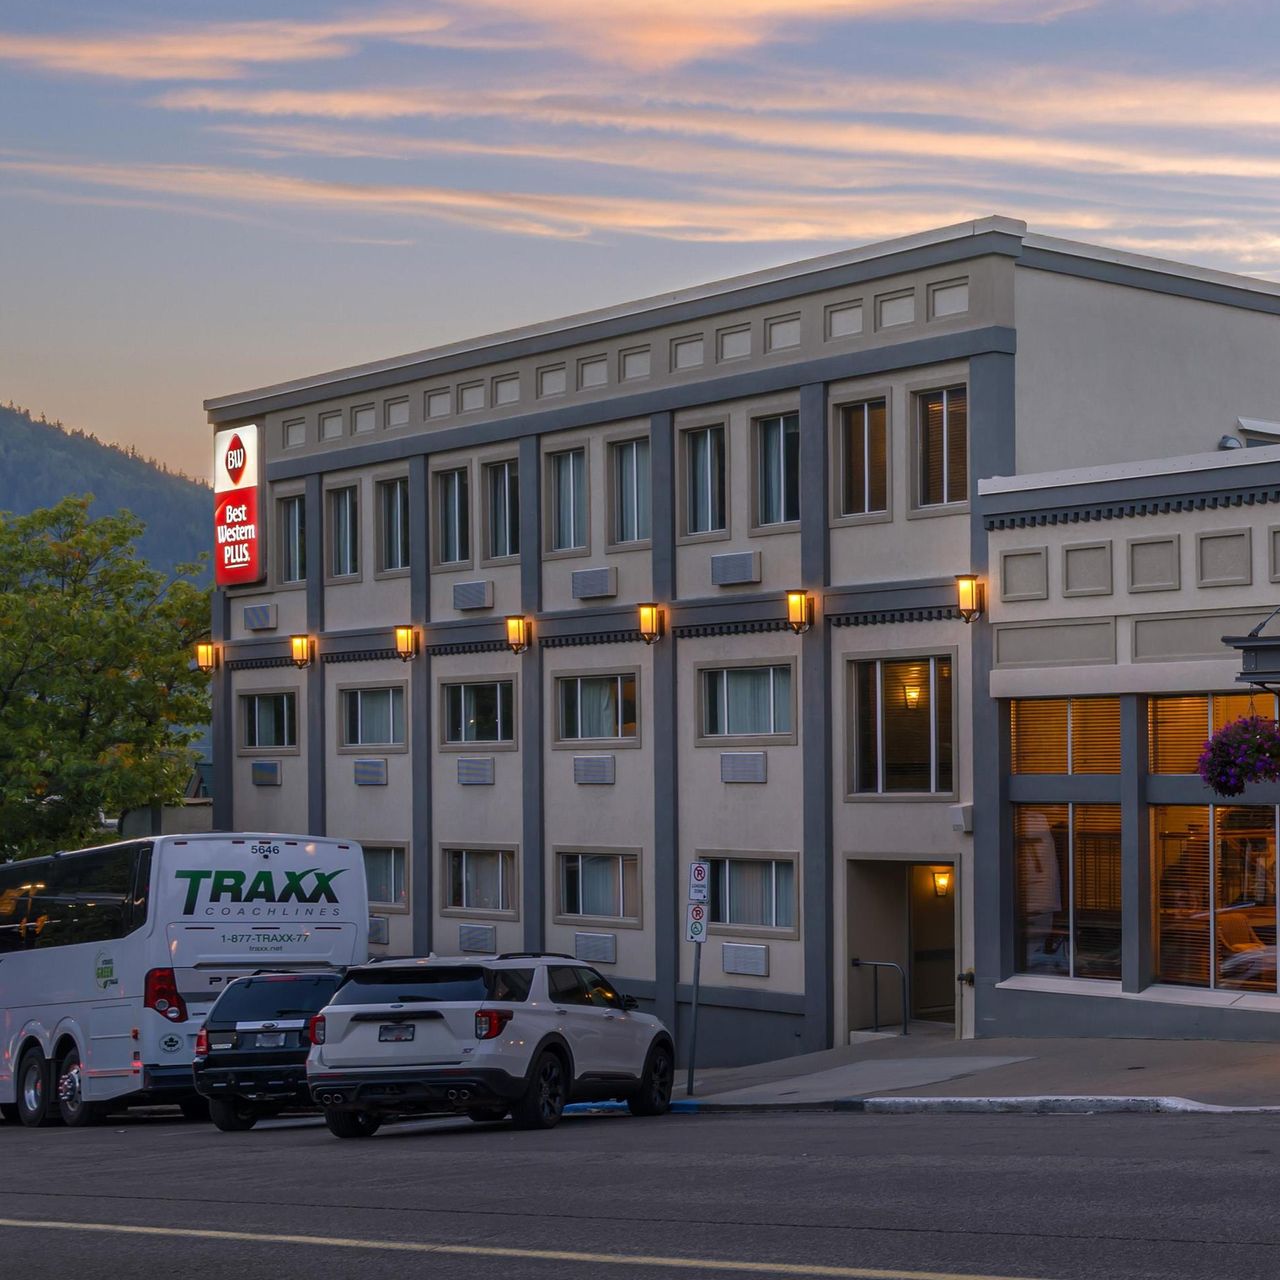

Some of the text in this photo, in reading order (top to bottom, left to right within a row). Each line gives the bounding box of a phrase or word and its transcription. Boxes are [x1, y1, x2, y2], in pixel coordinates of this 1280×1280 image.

[227, 447, 244, 470] BW
[225, 505, 247, 524] Best
[217, 523, 256, 545] Western
[251, 846, 279, 854] 5646
[175, 868, 350, 915] TRAXX
[205, 907, 340, 916] COACHLINES
[221, 934, 309, 943] 1-877-TRAXX-77
